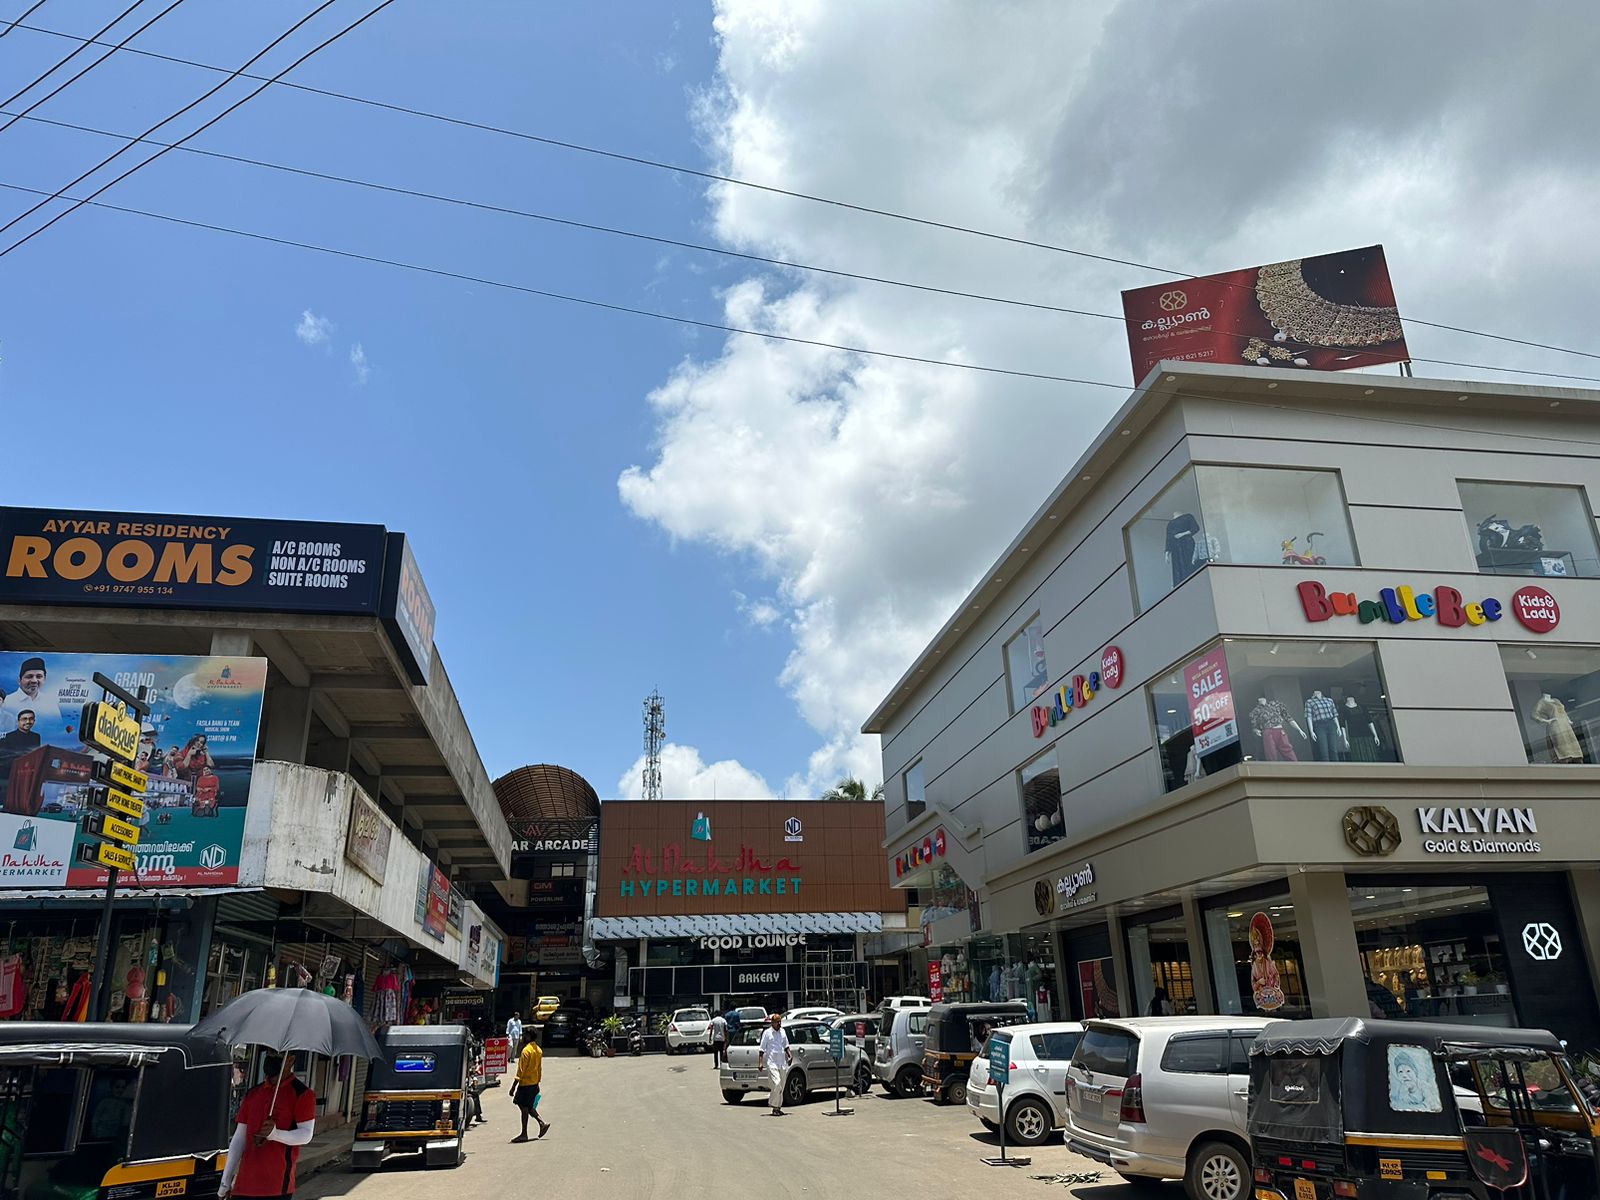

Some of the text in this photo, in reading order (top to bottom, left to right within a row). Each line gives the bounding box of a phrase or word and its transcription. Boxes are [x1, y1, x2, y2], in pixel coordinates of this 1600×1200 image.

[42, 519, 232, 540] AYYAR RESIDENCY
[271, 540, 342, 557] A/C ROOMS
[5, 535, 256, 586] ROOMS
[270, 556, 367, 574] NON A/C ROOMS
[268, 572, 349, 589] SUITE ROOMS
[94, 585, 174, 595] +91 9747 955 134
[1522, 607, 1557, 623] Lady
[114, 672, 156, 688] GRAND
[1102, 665, 1119, 680] Lady
[1192, 668, 1224, 699] SALE
[58, 689, 90, 698] HAMEED ALI
[1215, 695, 1229, 710] OFF
[1417, 807, 1538, 834] KALYAN
[535, 839, 589, 851] ARCADE
[1425, 840, 1541, 853] Gold & Diamonds
[0, 868, 63, 876] ERMARKET
[620, 877, 803, 898] HYPERMARKET
[700, 936, 743, 950] FOOD
[747, 933, 807, 949] LOUNGE
[738, 972, 780, 984] BAKERY
